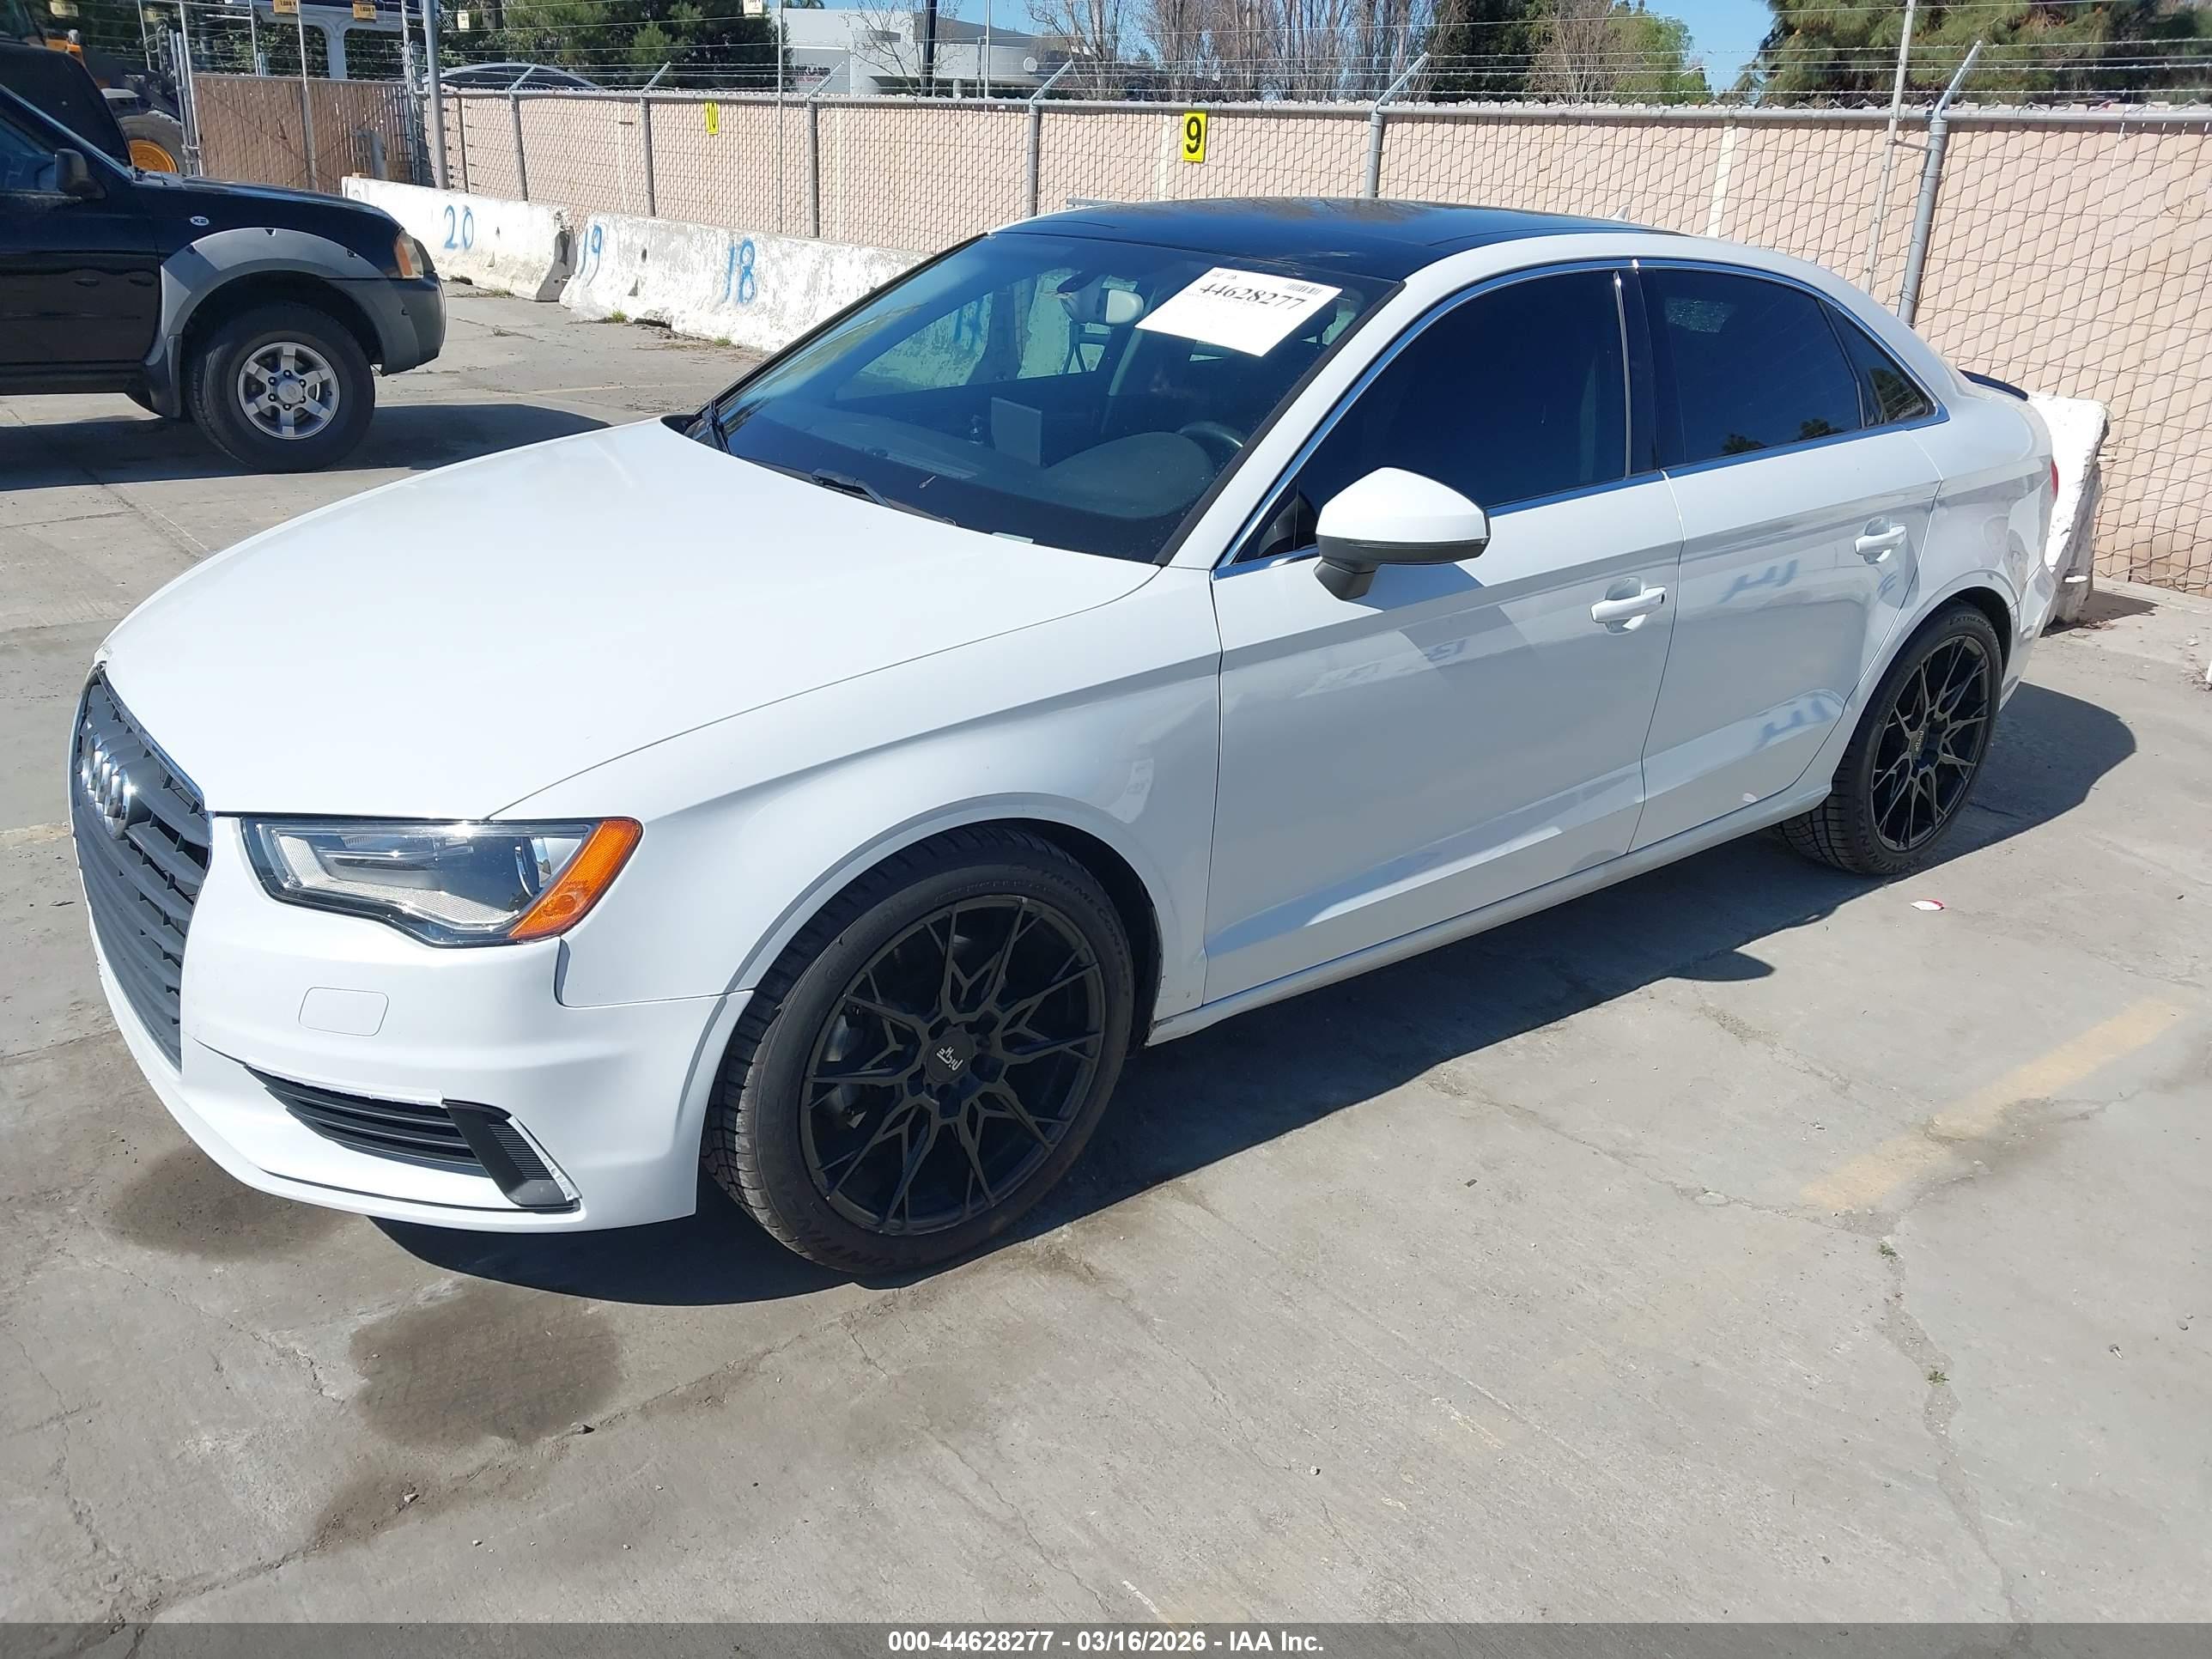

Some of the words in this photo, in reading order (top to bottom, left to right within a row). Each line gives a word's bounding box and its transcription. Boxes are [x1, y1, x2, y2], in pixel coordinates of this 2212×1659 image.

[707, 102, 716, 130] 10
[1186, 116, 1202, 155] 9
[443, 204, 475, 250] 20
[576, 224, 603, 287] 19
[725, 237, 757, 303] 18
[1199, 283, 1307, 310] 44628277
